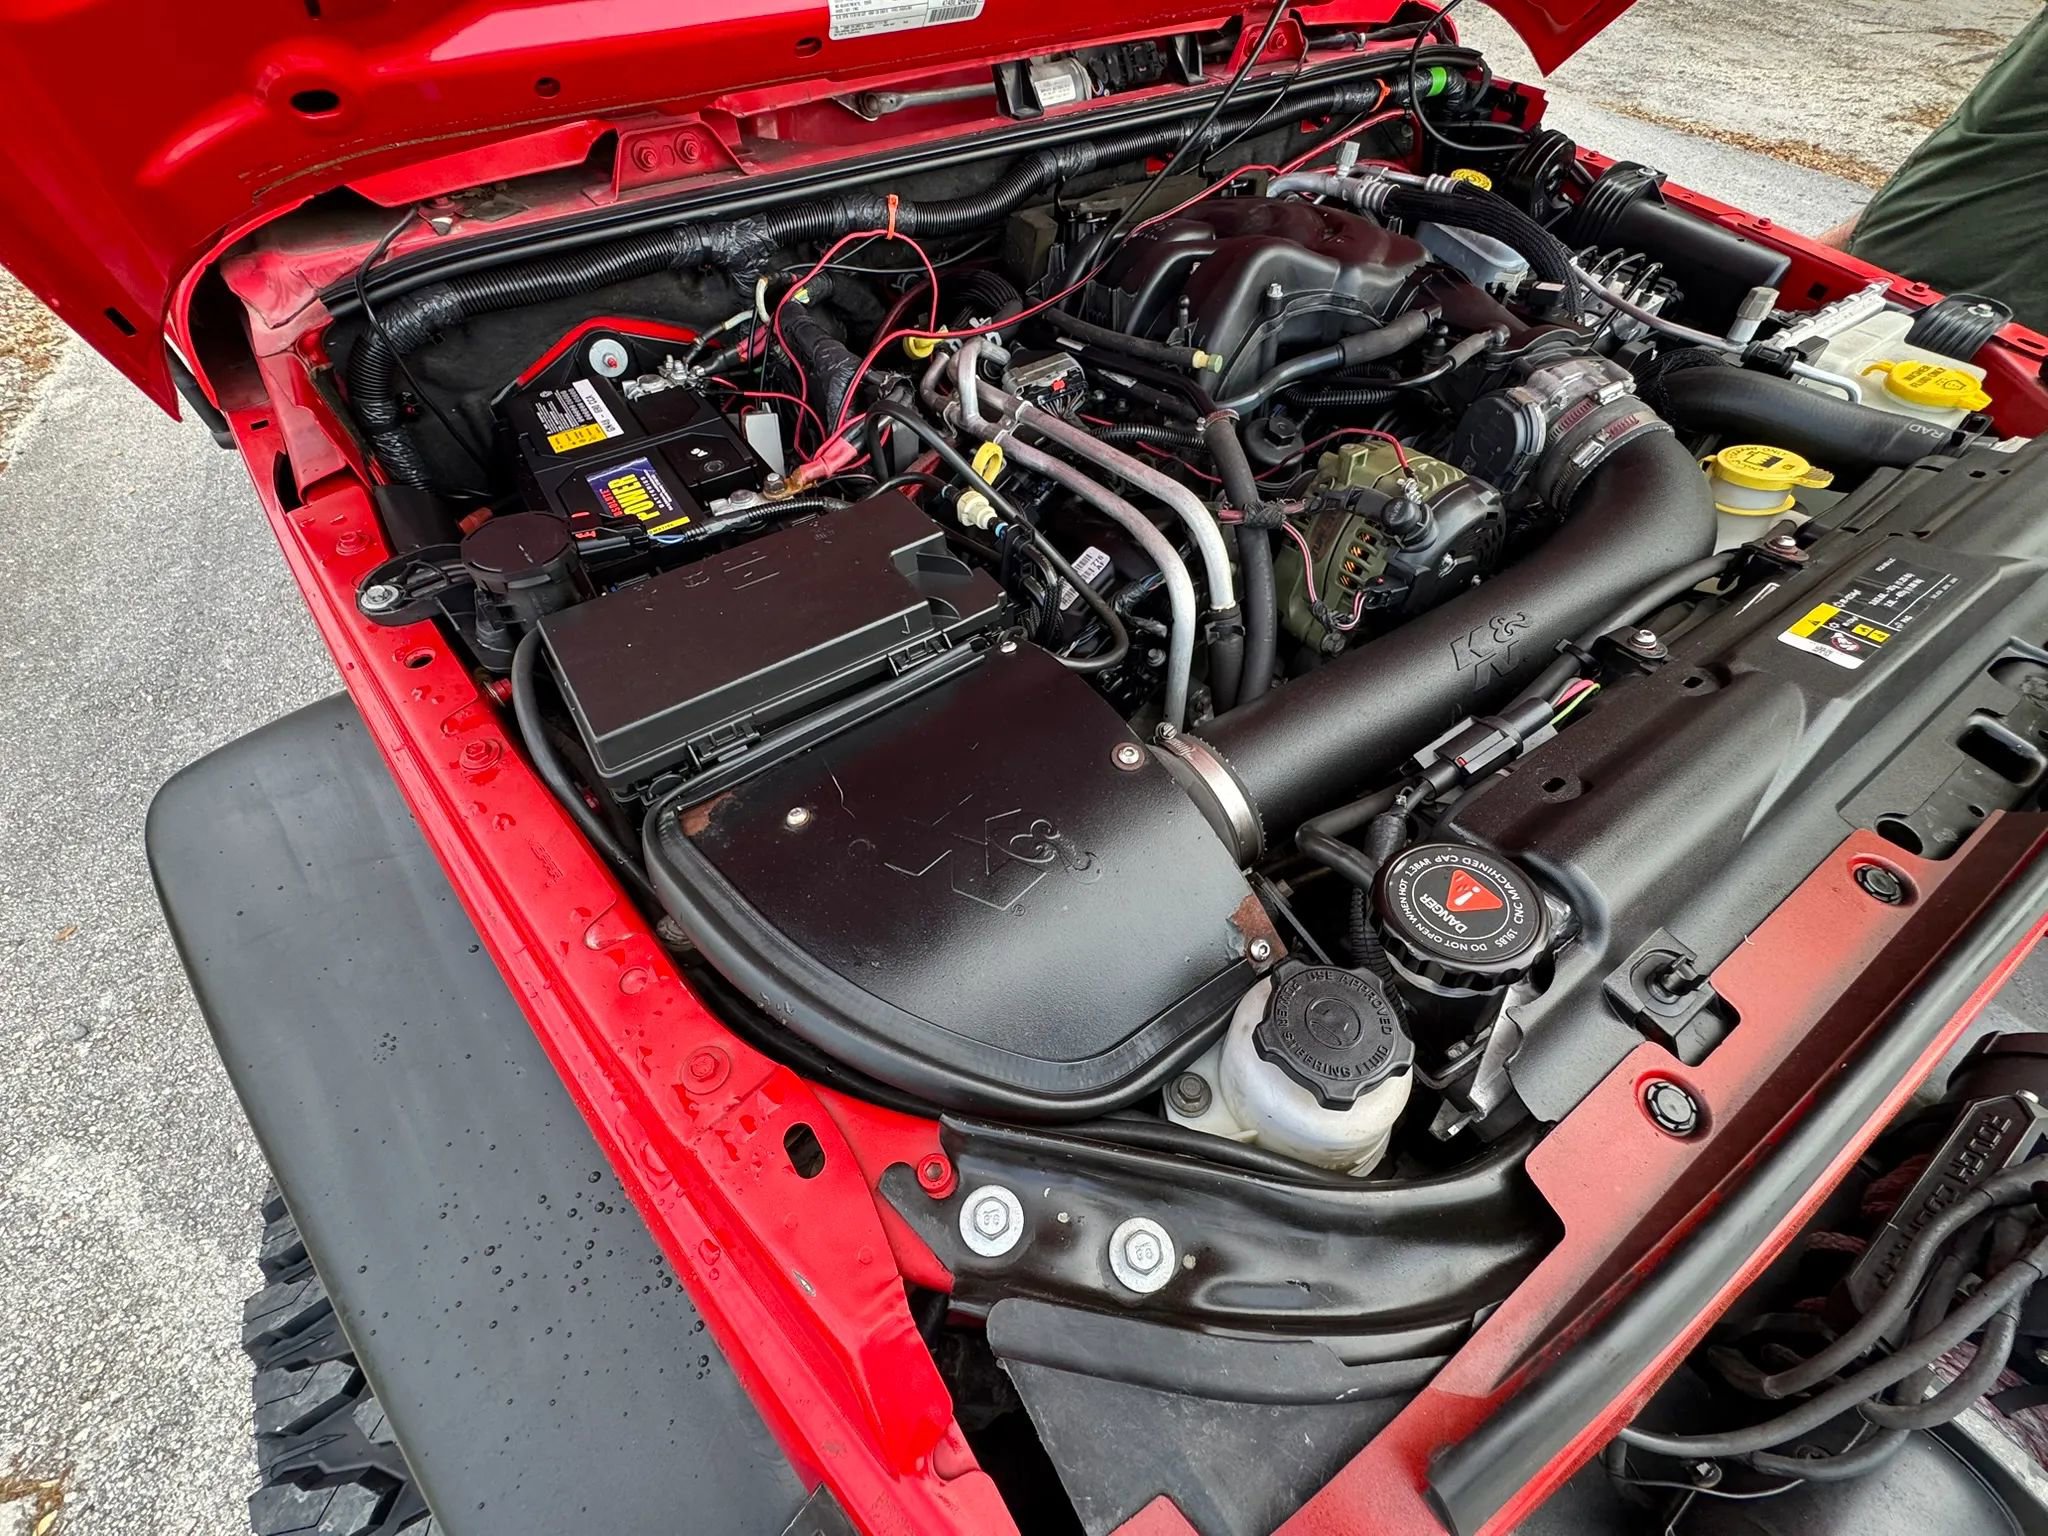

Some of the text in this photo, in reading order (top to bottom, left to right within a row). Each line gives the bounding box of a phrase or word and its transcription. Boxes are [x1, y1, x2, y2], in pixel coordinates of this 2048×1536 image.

[1908, 424, 1945, 439] RAD
[608, 474, 660, 521] POWER
[1398, 878, 1488, 951] DO NOT OPEN WHEN HOT
[1419, 893, 1468, 934] DANGER
[1434, 854, 1524, 925] CNC MACHINED CAP
[1494, 928, 1518, 948] 19LBS
[1278, 981, 1390, 1078] POWER STEERING FLUID
[1305, 970, 1393, 1036] USE APPROVED
[1944, 1113, 2012, 1185] ROUGH
